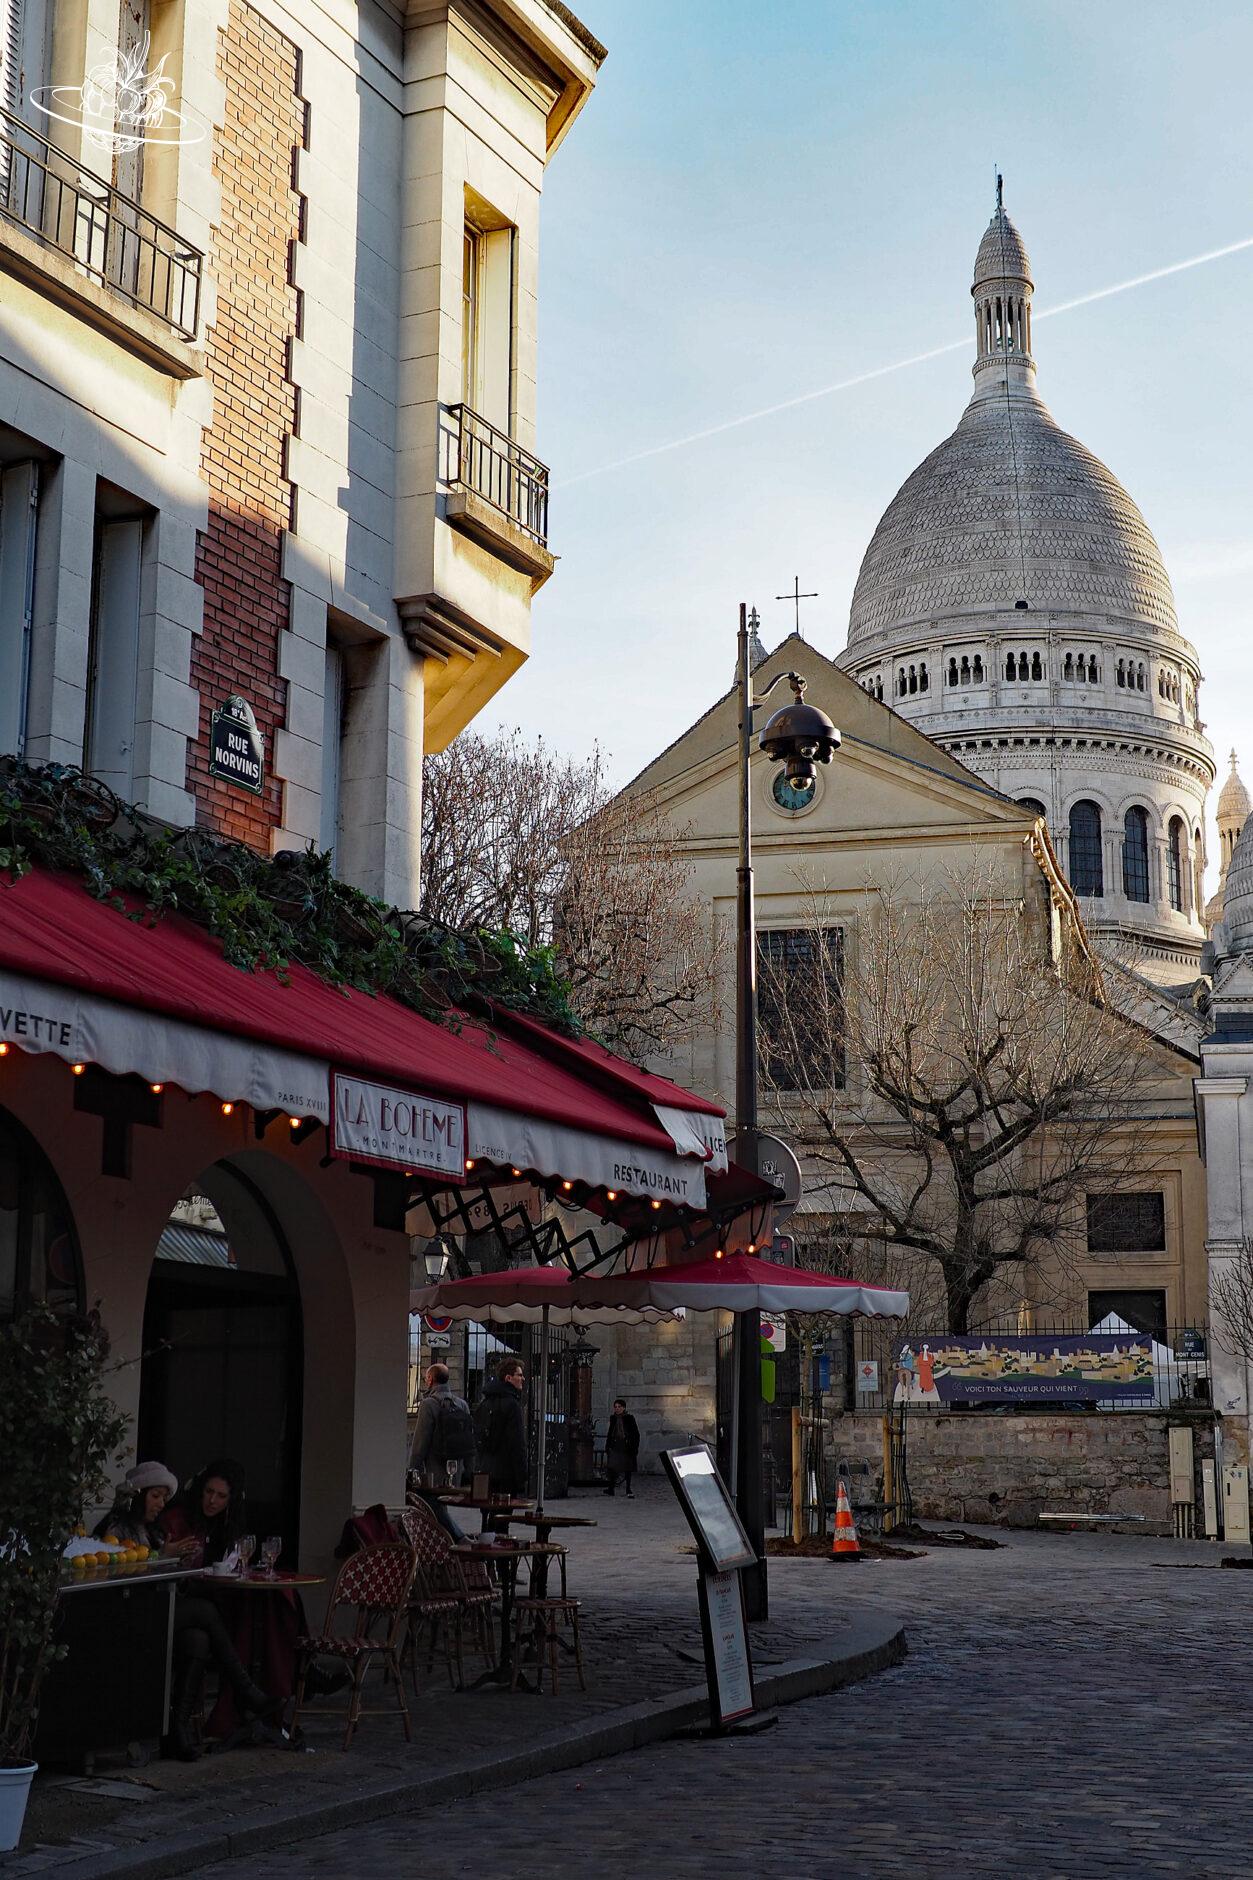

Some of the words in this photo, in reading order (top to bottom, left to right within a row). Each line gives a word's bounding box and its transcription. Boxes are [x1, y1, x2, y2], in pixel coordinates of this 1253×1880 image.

[228, 732, 249, 755] RUE
[215, 746, 259, 779] NORVINS
[278, 1091, 304, 1106] PARIS
[344, 1088, 369, 1126] LA
[380, 1097, 457, 1148] BOHEME
[475, 1144, 504, 1160] LICENCE
[613, 1163, 688, 1195] RESTAURANT
[964, 1385, 985, 1393] VOICI
[986, 1385, 1002, 1393] TON
[1003, 1385, 1039, 1393] SAUVEUR
[1040, 1385, 1054, 1393] QUI
